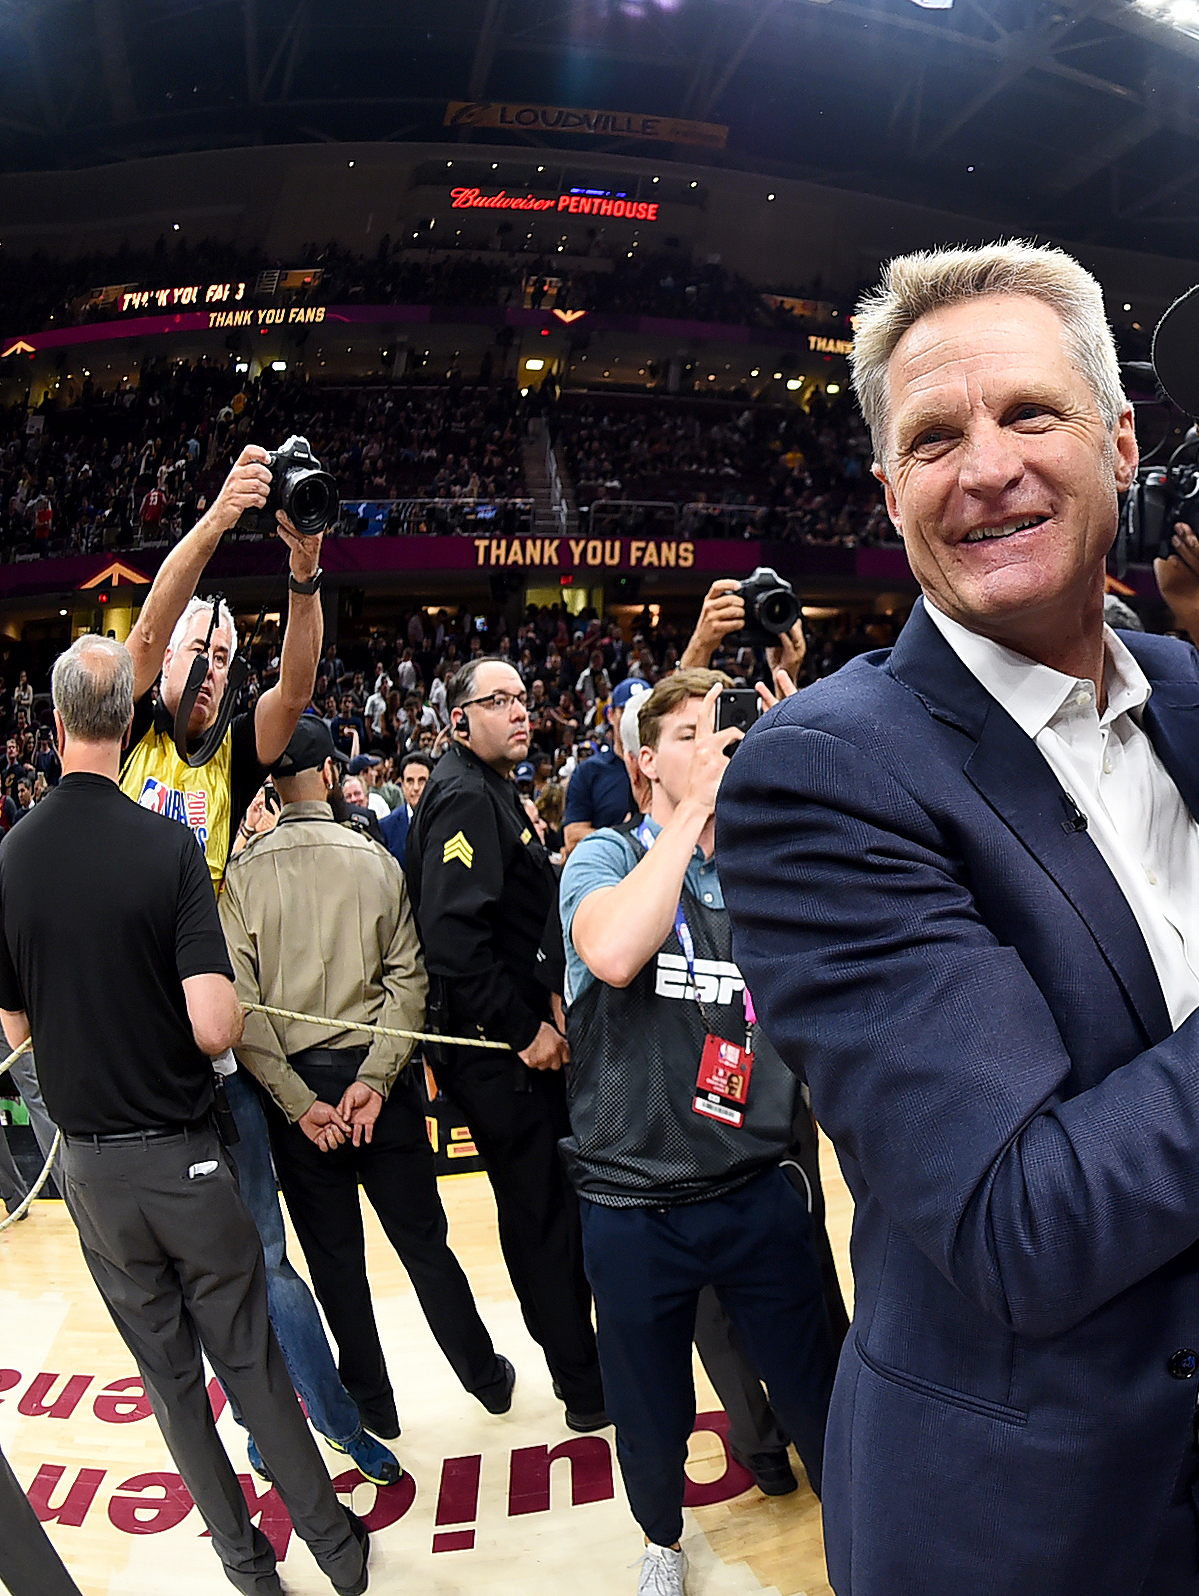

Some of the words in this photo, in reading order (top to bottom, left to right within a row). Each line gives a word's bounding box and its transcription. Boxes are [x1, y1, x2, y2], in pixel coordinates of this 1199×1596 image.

[500, 108, 660, 136] LOUDVILLE
[450, 187, 556, 211] Budweiser
[557, 195, 660, 221] PENTHOUSE
[209, 310, 252, 328] THANK
[257, 308, 286, 325] YOU
[288, 306, 327, 324] FANS
[474, 538, 560, 567] THANK
[568, 538, 622, 567] YOU
[629, 540, 695, 568] FANS
[186, 791, 207, 826] 2018
